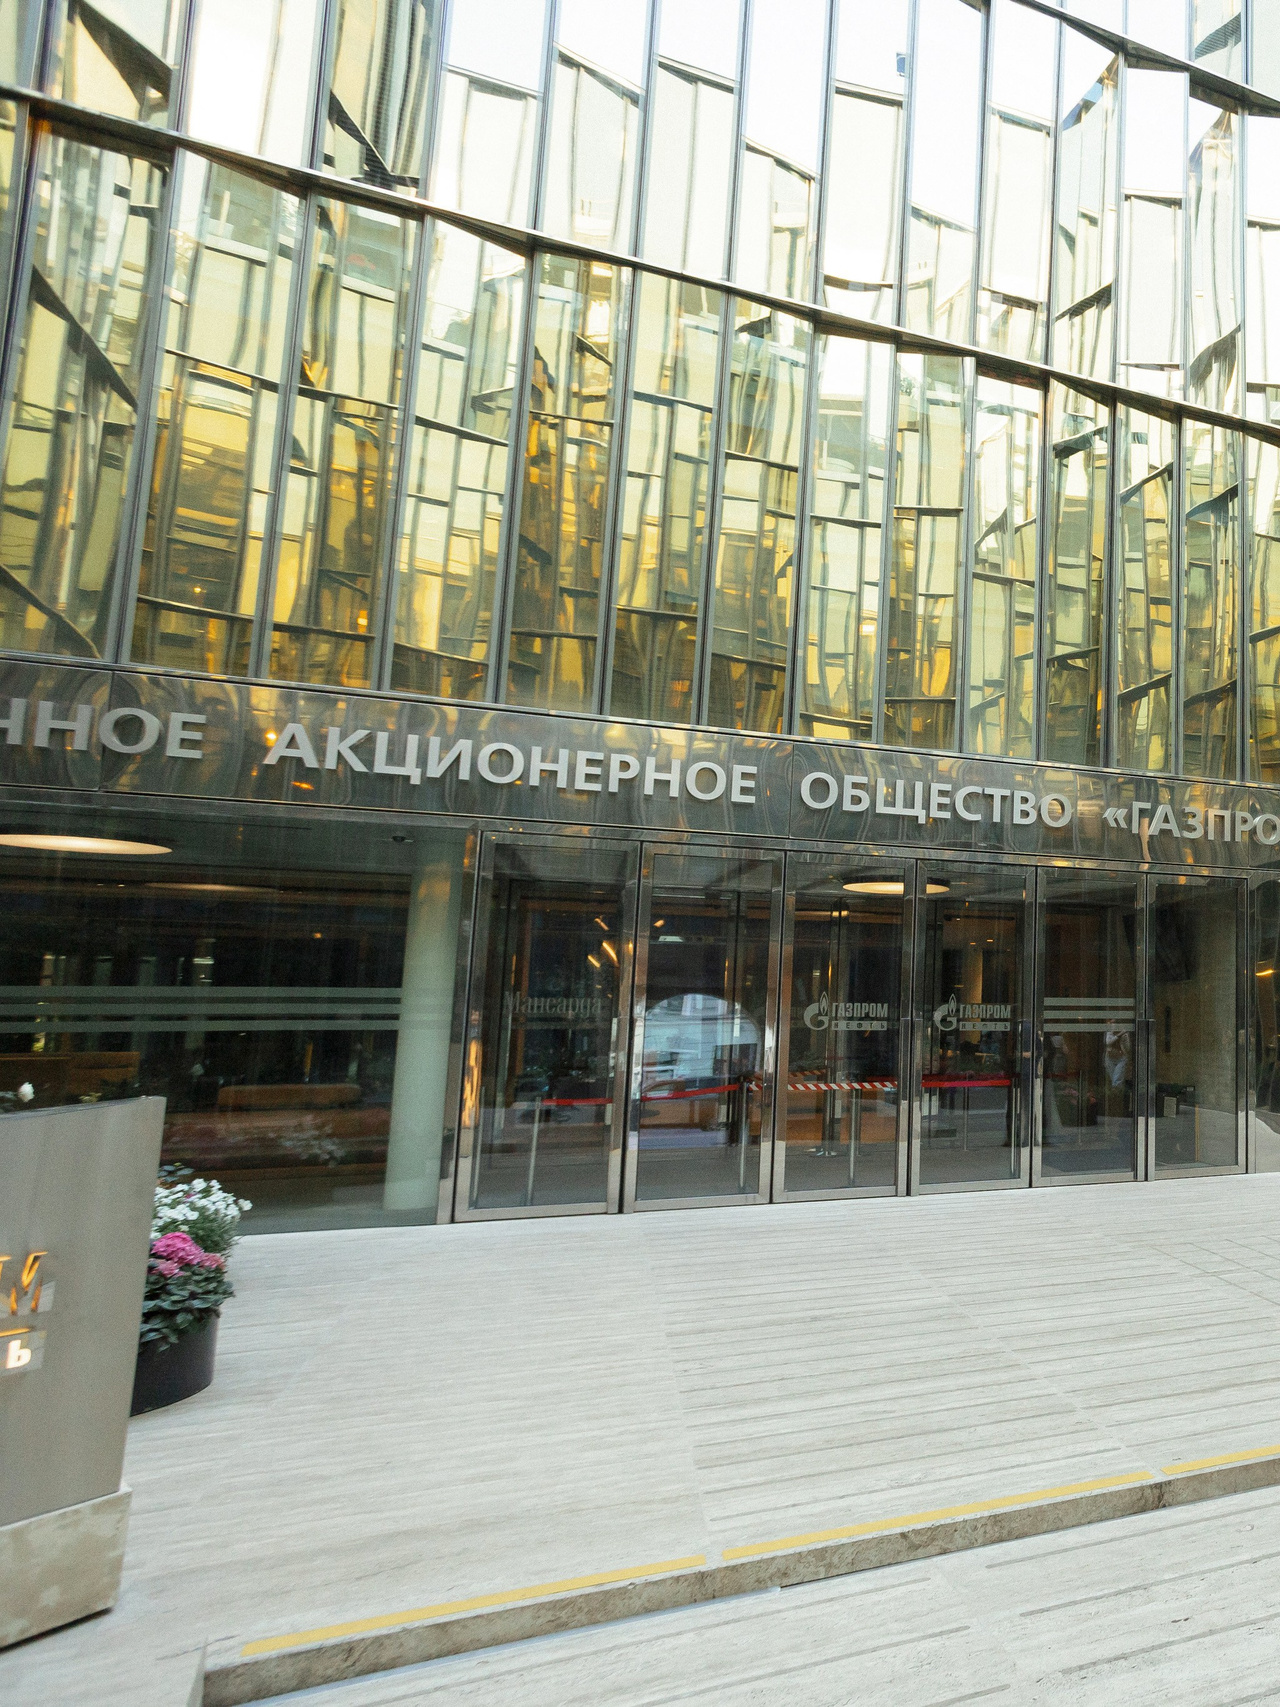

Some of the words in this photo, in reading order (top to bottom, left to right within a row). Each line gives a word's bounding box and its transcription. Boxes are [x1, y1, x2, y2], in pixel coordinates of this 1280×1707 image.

[263, 722, 758, 804] АКЦИОНЕРНОЕ
[800, 771, 1073, 828] ОБЩЕСТВО
[831, 1002, 889, 1018] ГАЗПРОМ
[959, 1003, 1012, 1019] ГАЗПРОМ
[832, 1021, 887, 1031] НЕФТЬ
[960, 1022, 1010, 1031] НЕФТЬ
